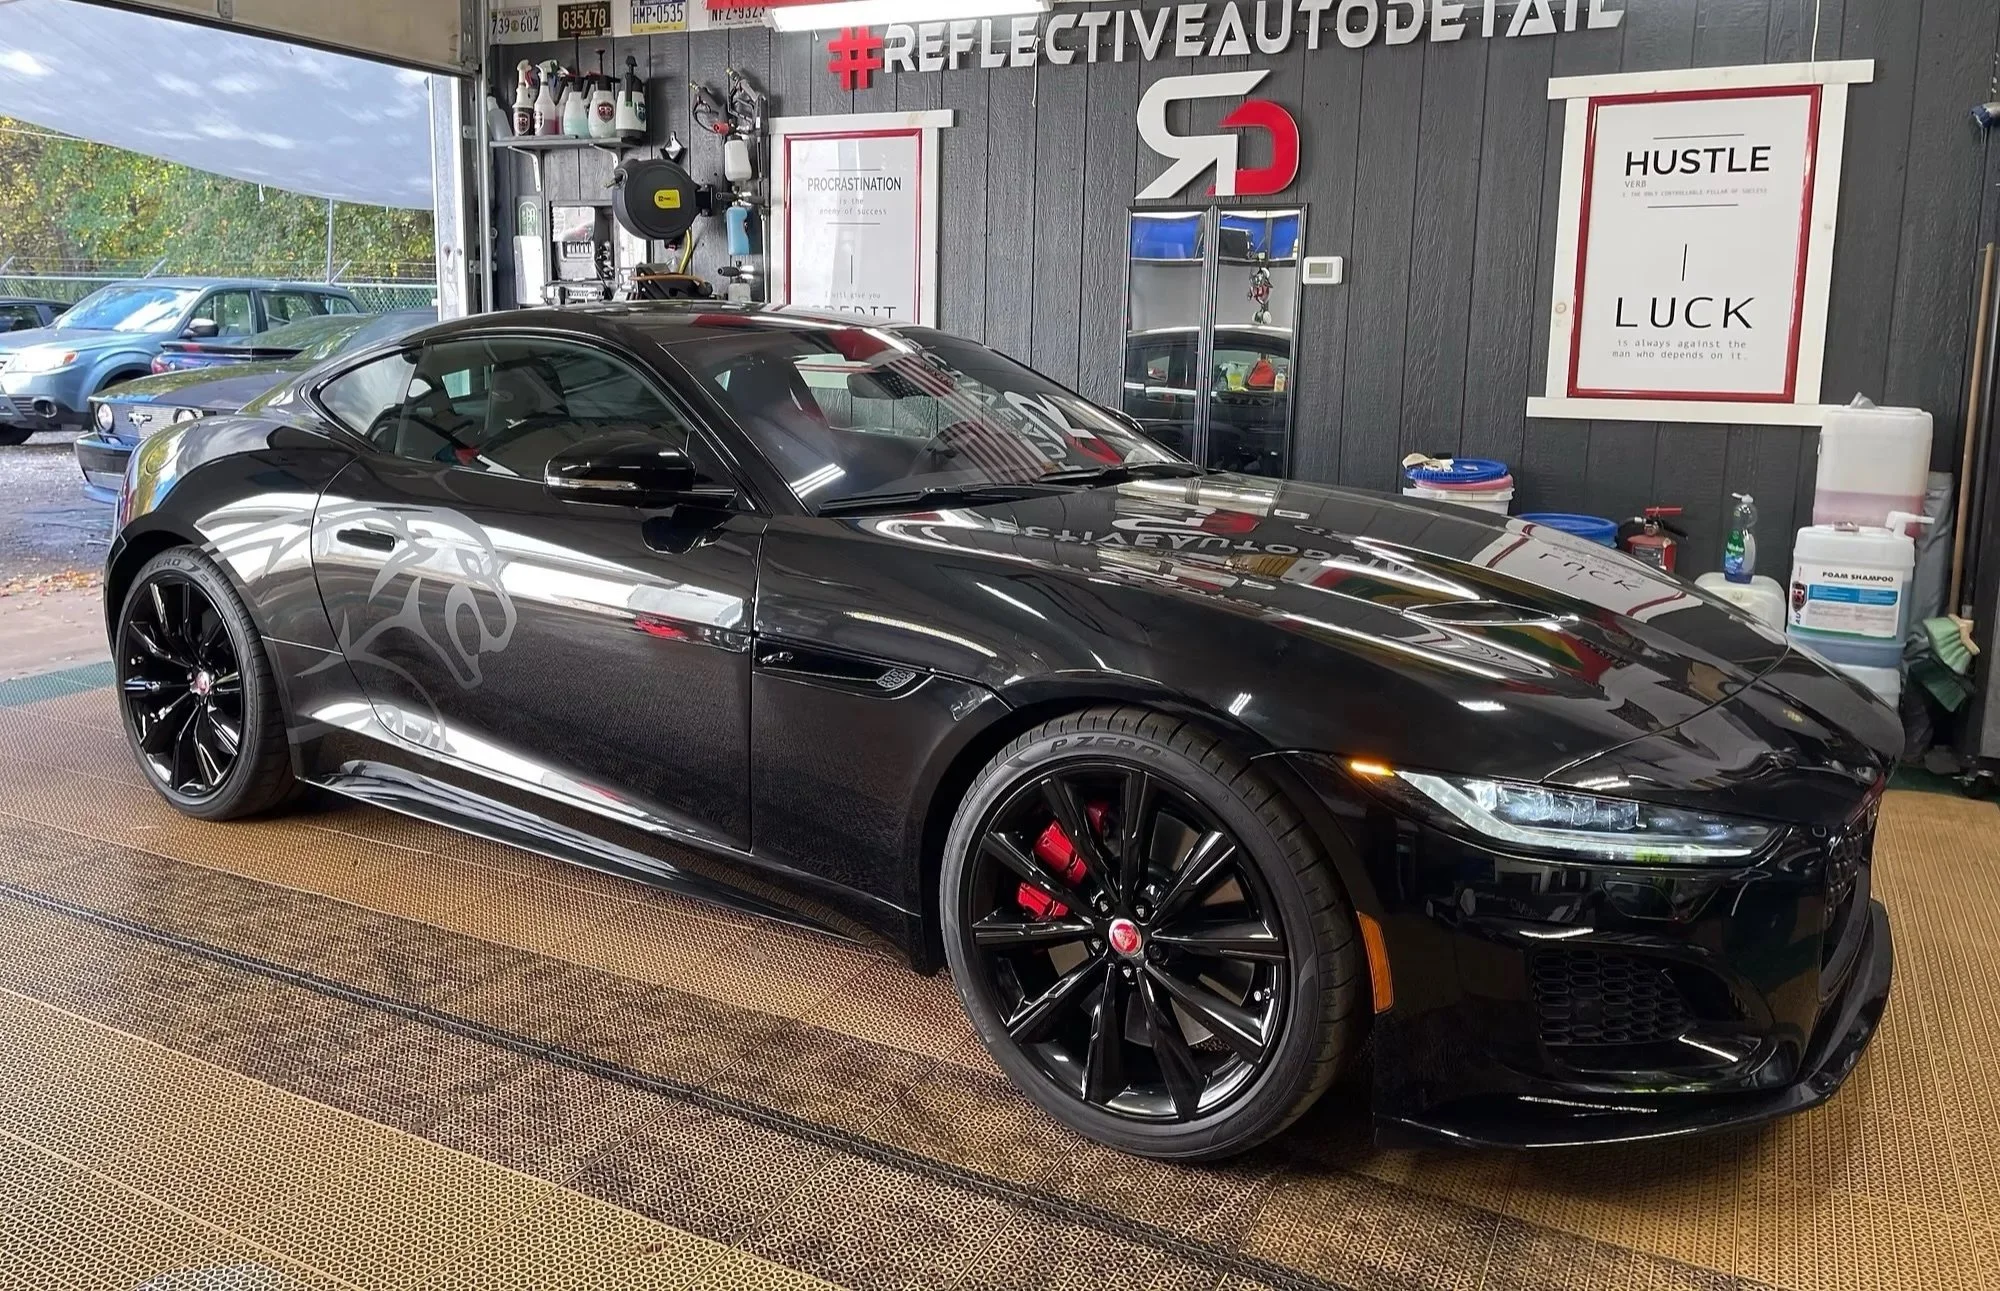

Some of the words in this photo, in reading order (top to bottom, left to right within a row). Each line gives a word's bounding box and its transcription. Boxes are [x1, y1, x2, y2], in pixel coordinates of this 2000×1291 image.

[562, 8, 607, 30] 835478
[1625, 146, 1771, 176] HUSTLE
[807, 176, 902, 192] PROCRASTINATION
[1624, 180, 1647, 188] VERB
[852, 197, 864, 205] the
[819, 208, 841, 217] enemy
[1615, 297, 1754, 329] LUCK
[1618, 338, 1629, 348] is
[1635, 337, 1671, 350] always
[1677, 338, 1720, 351] against
[1728, 339, 1747, 349] the
[1612, 350, 1631, 358] man
[1636, 349, 1655, 359] who
[1660, 349, 1704, 362] depends
[1710, 351, 1723, 360] on
[1822, 571, 1848, 579] FOAM
[1851, 574, 1894, 582] SHAMPOO
[1075, 736, 1163, 756] ZERO
